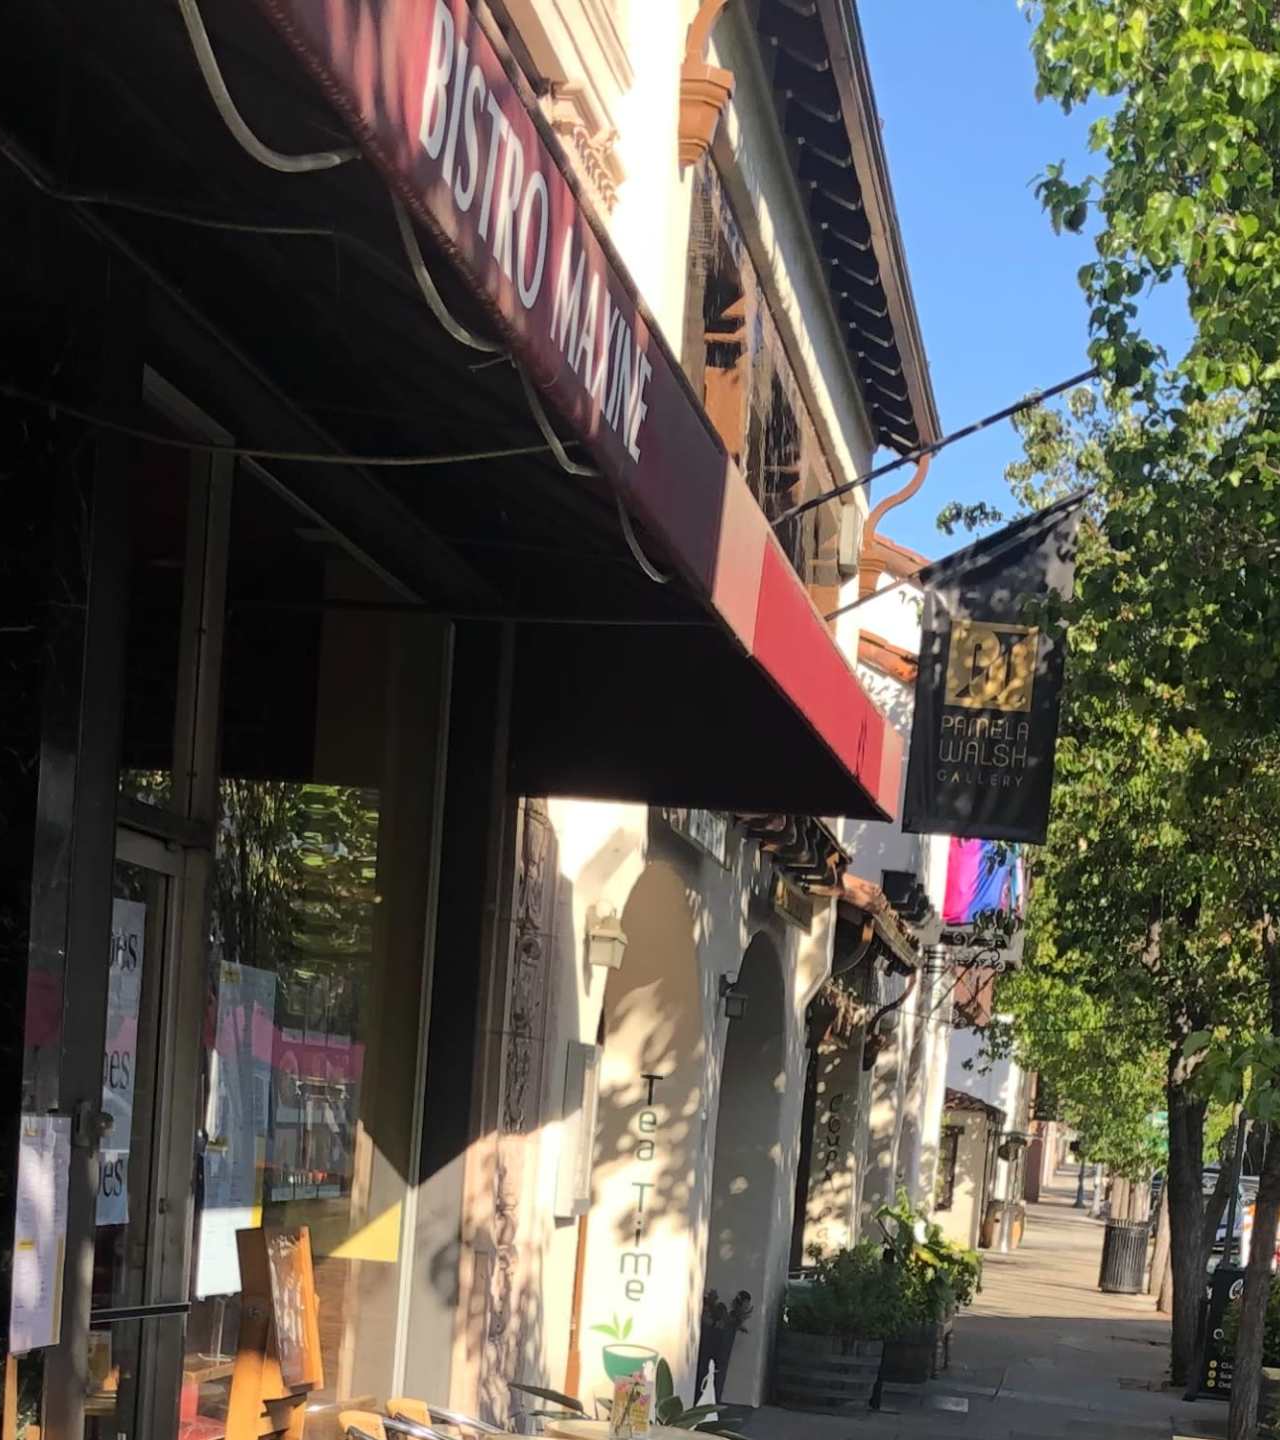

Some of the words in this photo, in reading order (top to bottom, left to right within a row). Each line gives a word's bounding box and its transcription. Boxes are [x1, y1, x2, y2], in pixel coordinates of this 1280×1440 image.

[419, 0, 548, 310] BISTRO
[549, 225, 652, 464] MAXINE
[938, 740, 1028, 769] WALSH
[940, 715, 1030, 741] PAMELA
[936, 768, 1024, 788] GALLERY
[636, 1074, 664, 1162] Tea
[620, 1181, 656, 1302] Time
